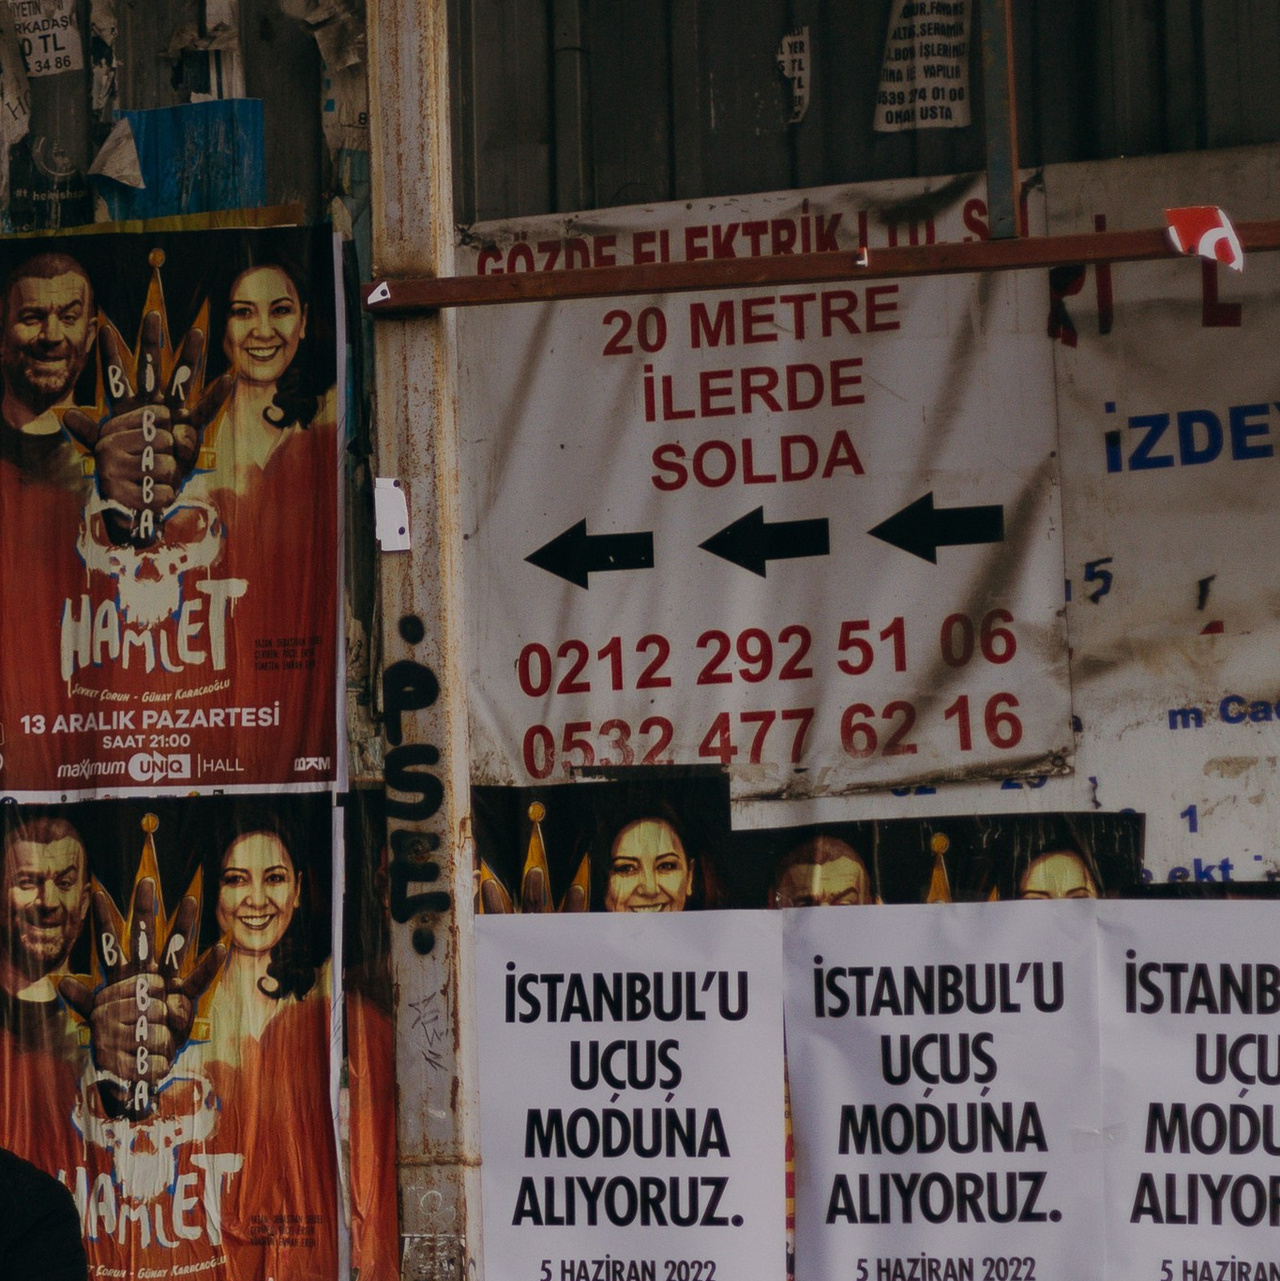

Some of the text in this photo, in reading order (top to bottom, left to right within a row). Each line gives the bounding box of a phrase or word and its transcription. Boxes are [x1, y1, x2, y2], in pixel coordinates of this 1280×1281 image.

[39, 33, 65, 55] TL
[602, 284, 901, 357] 20 METRE
[643, 356, 866, 423] İLERDE
[650, 429, 866, 492] SOLDA
[1104, 402, 1280, 475] İZDE
[60, 577, 250, 682] HAMLET
[519, 607, 1018, 698] 0212 292 51 06
[21, 700, 281, 735] 13 PAZARTESİ
[522, 691, 1024, 780] 0532 477 62 16
[505, 961, 749, 1024] İSTANBUL'U
[814, 954, 1064, 1018] İSTANBUL'U
[570, 1039, 683, 1103] UÇUŞ
[880, 1031, 998, 1098] UÇUŞ
[524, 1107, 730, 1158] MODUNA
[837, 1101, 1049, 1155] MODUNA
[512, 1176, 744, 1227] ALIYORUZ.
[825, 1170, 1063, 1225] ALIYORUZ.
